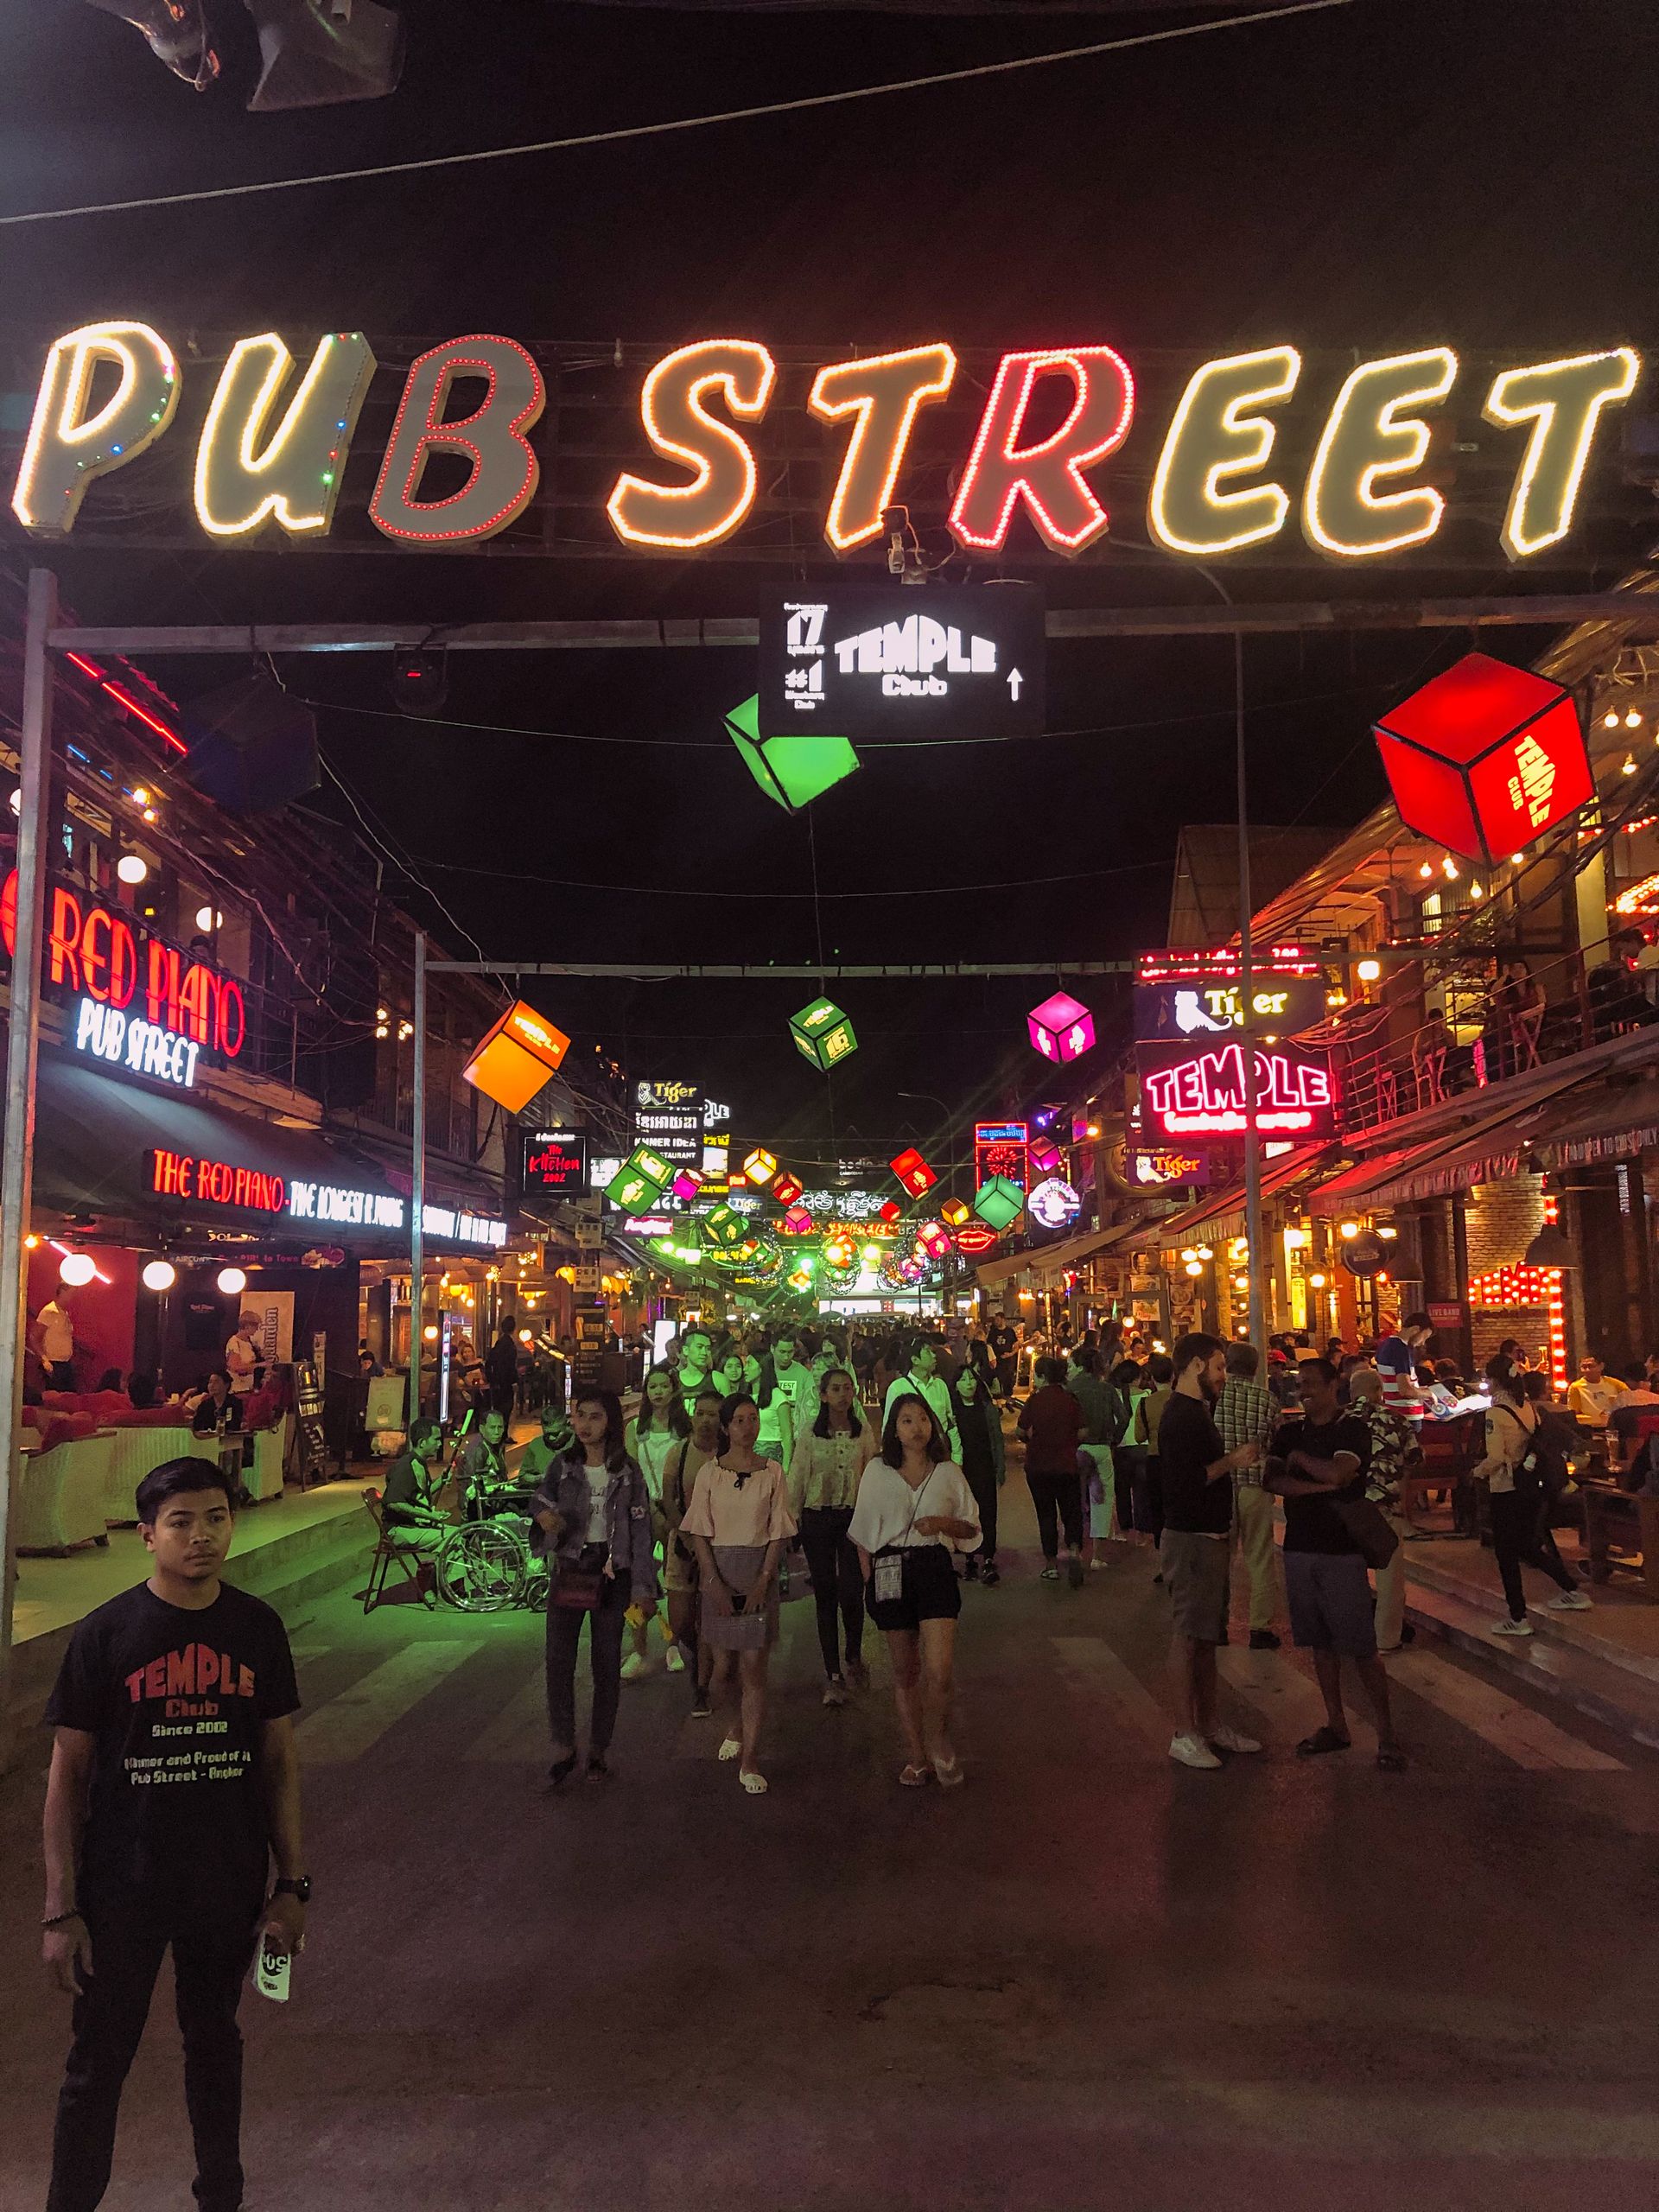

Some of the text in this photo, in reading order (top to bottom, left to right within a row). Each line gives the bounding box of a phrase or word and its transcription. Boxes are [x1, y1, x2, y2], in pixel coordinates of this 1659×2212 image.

[12, 321, 1642, 563] PUB STREET
[787, 609, 825, 645] 17
[835, 614, 996, 673] TEMPLE
[785, 659, 823, 692] #1
[882, 674, 948, 696] Club
[1514, 734, 1556, 829] TEMPLE
[48, 887, 245, 1058] RED PIANO
[76, 997, 200, 1088] PUB STREET
[654, 1082, 697, 1103] Tiger
[660, 1151, 696, 1160] STAURANT
[1154, 1154, 1201, 1179] Tiger
[154, 1148, 194, 1198] THE
[198, 1159, 233, 1205] RED
[236, 1167, 284, 1213] PIANO
[125, 1643, 256, 1703] TEMPLE
[165, 1699, 219, 1718] Club
[151, 1721, 228, 1738] Since 2002
[166, 1752, 191, 1766] and
[194, 1751, 227, 1765] Proud
[228, 1751, 240, 1762] of
[130, 1772, 151, 1786] Pub
[153, 1770, 198, 1783] Street
